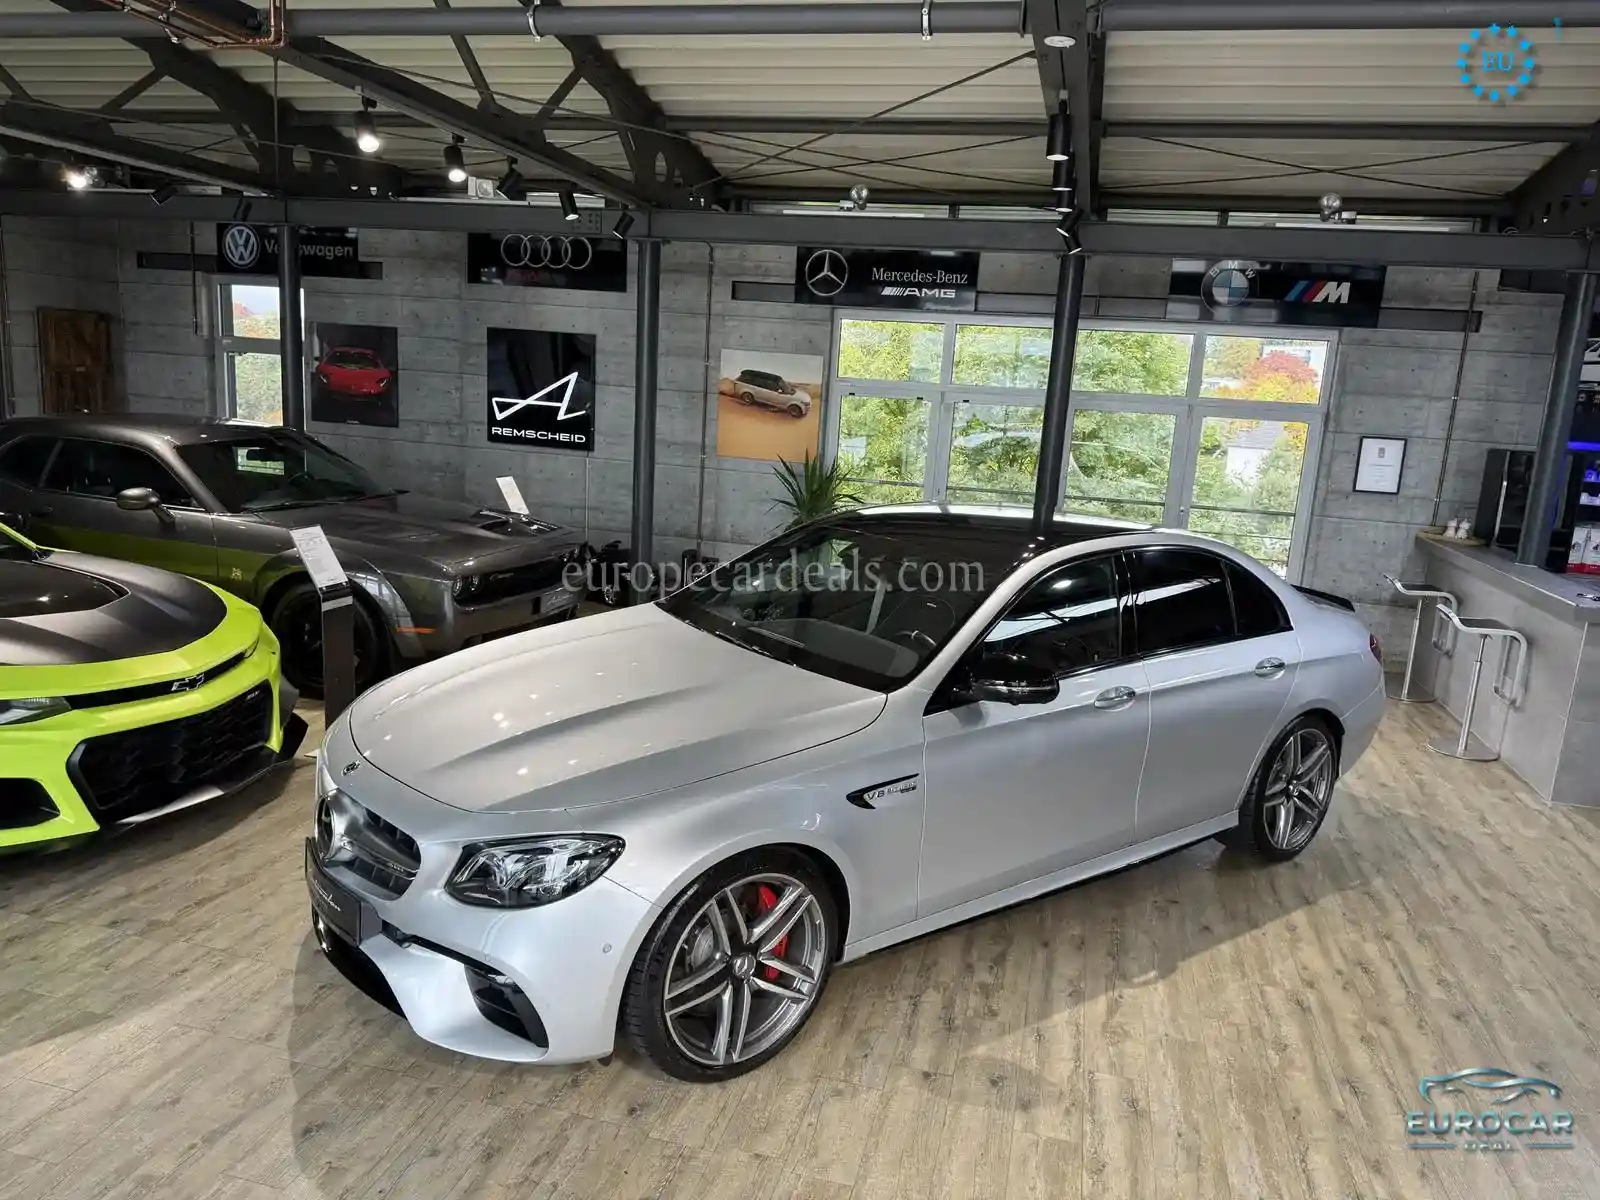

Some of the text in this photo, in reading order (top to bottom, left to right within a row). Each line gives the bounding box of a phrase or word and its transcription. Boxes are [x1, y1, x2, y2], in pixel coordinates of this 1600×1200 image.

[871, 267, 968, 284] Mercedes-Benz
[903, 287, 956, 298] AMG
[491, 426, 586, 443] REMSCHEID
